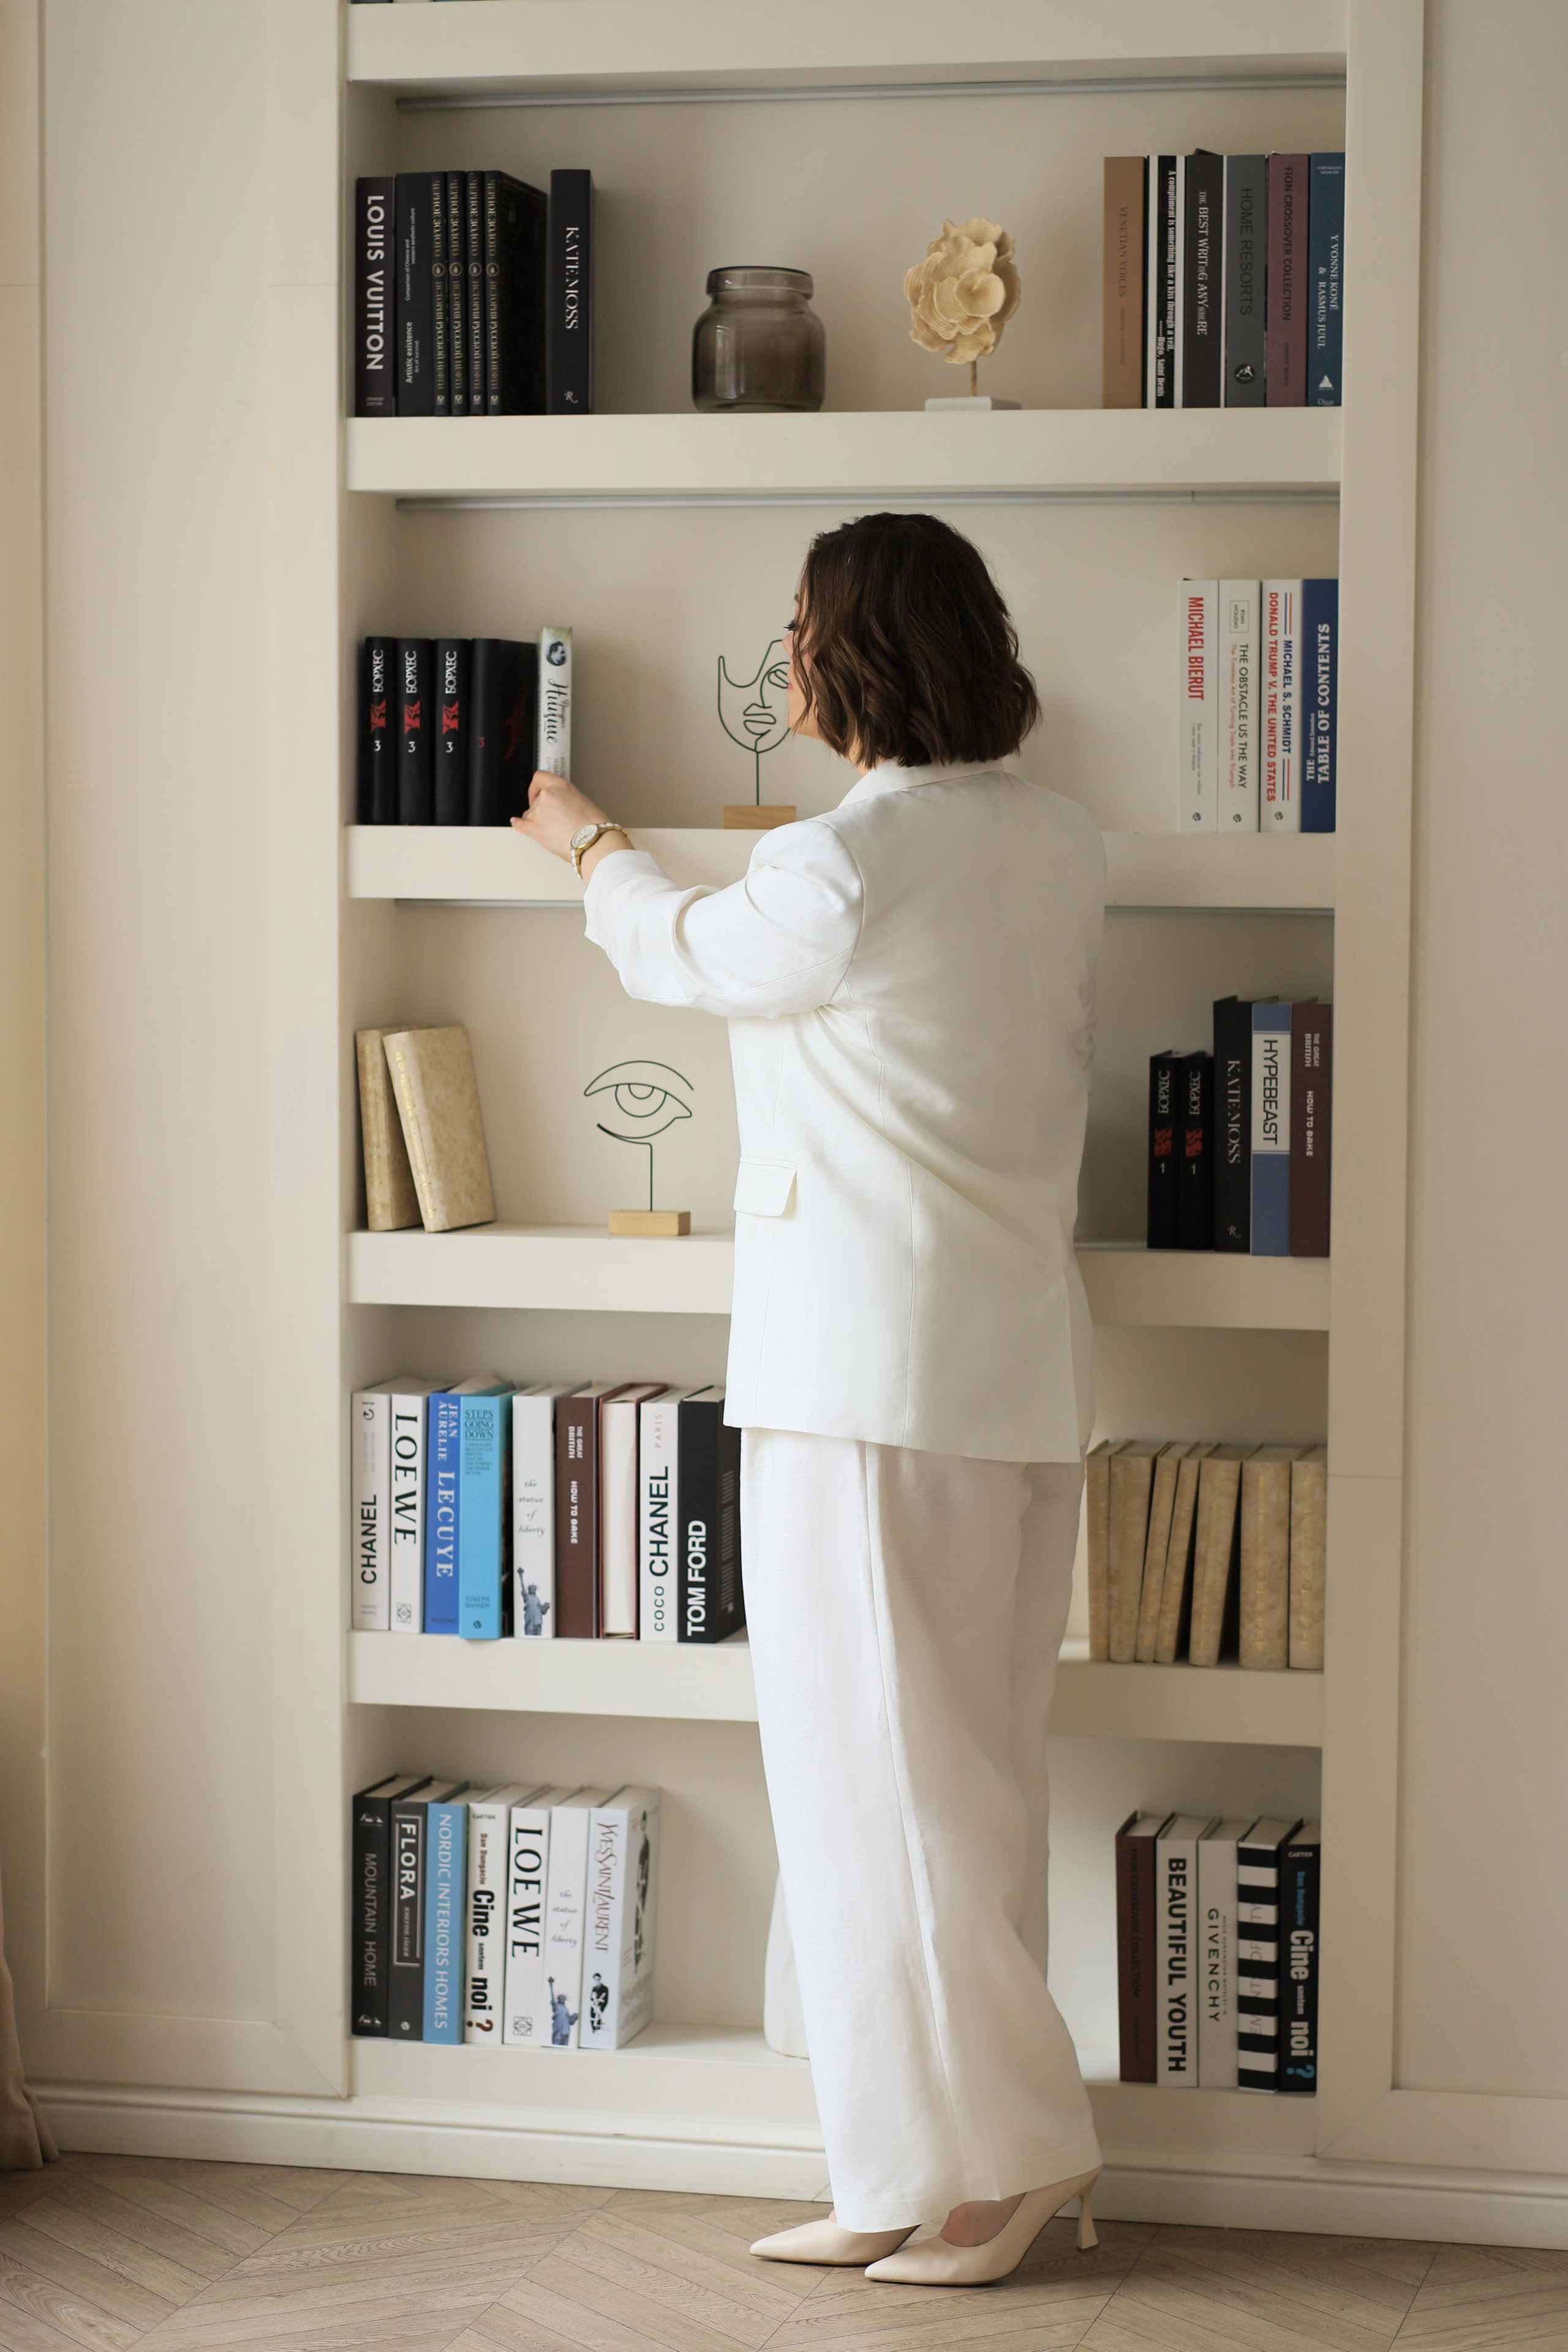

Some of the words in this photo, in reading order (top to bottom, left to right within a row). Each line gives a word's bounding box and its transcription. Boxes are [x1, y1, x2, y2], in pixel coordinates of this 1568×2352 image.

[1167, 177, 1175, 217] compliment
[1284, 167, 1293, 191] FION
[367, 195, 385, 260] LOUIS
[1118, 206, 1128, 258] VENETIAN
[1198, 207, 1209, 236] BEST
[1240, 188, 1253, 235] HOME
[1283, 195, 1293, 255] CROSSOVER
[565, 227, 579, 275] KATE
[1166, 227, 1175, 263] something
[1118, 261, 1128, 297] VOICES
[1239, 241, 1253, 315] RESORTS
[1283, 258, 1292, 320] COLLECTION
[1329, 282, 1340, 311] KONÉ
[366, 270, 385, 370] VUITTON
[565, 277, 579, 330] MOSS
[1166, 301, 1175, 328] through
[1317, 282, 1327, 322] RASMUS
[405, 322, 413, 356] existence
[1316, 324, 1326, 349] JUUL
[405, 357, 413, 383] Artistic
[1188, 597, 1204, 652] MICHAEL
[1269, 592, 1279, 636] DONALD
[372, 649, 384, 692] БОРХЕС
[405, 650, 418, 693] БОРХЕС
[445, 651, 457, 694] БОРХЕС
[1239, 644, 1248, 663] THE
[1268, 639, 1278, 677] TRUMP
[1283, 640, 1292, 688] MICHAEL
[1317, 623, 1330, 706] CONTENTS
[1188, 656, 1204, 700] BIERUT
[1238, 667, 1248, 720] OBSTACLE
[1268, 681, 1277, 690] V.
[1283, 692, 1292, 701] S.
[1268, 693, 1277, 714] THE
[1317, 710, 1330, 731] OF
[374, 740, 382, 752] 3
[408, 741, 416, 753] 3
[446, 741, 454, 753] 3
[478, 737, 485, 748] 3
[1238, 724, 1248, 738] US
[1267, 718, 1276, 758] UNITED
[1281, 705, 1292, 754] SCHMIDT
[1238, 742, 1248, 762] THE
[1306, 759, 1315, 781] THE
[1317, 736, 1330, 783] TABLE
[1238, 764, 1247, 789] WAY
[1267, 761, 1276, 801] STATES
[1158, 1070, 1170, 1114] БОРХЕС
[1189, 1071, 1200, 1115] БОРХЕС
[1227, 1060, 1241, 1110] KATE
[1262, 1039, 1278, 1145] HYPEBEAST
[1227, 1112, 1241, 1164] MOSS
[1306, 1116, 1313, 1128] TO
[1159, 1163, 1164, 1174] 1
[1191, 1164, 1196, 1175] 1
[437, 1401, 448, 1461] AURELIE
[448, 1403, 458, 1438] JEAN
[465, 1409, 493, 1418] STEPS
[465, 1430, 494, 1439] DOWN
[394, 1414, 418, 1545] LOEWE
[435, 1471, 456, 1578] LECUYE
[518, 1526, 546, 1538] liberty
[527, 1510, 537, 1520] of
[570, 1505, 578, 1517] TO
[649, 1466, 669, 1577] CHANEL
[360, 1494, 377, 1585] CHANEL
[687, 1520, 707, 1581] FORD
[654, 1586, 665, 1632] COCO
[687, 1593, 706, 1636] TOM
[400, 1823, 416, 1900] FLORA
[437, 1814, 452, 1878] NORDIC
[364, 1853, 377, 1932] MOUNTAIN
[512, 1827, 543, 1958] LOEWE
[1296, 1871, 1306, 1887] Dan
[435, 1883, 451, 1966] INTERIORS
[472, 1890, 495, 1937] Cine
[560, 1921, 568, 1930] of
[1168, 1858, 1186, 1986] BEAUTIFUL
[551, 1937, 578, 1947] liberty
[1290, 1930, 1314, 1980] Cine
[364, 1942, 377, 1986] HOME
[1208, 1909, 1219, 2022] GIVENCHY
[434, 1970, 448, 2029] HOMES
[472, 1977, 492, 2010] noi
[466, 2019, 493, 2032] ?
[1168, 1993, 1186, 2072] YOUTH
[1290, 2021, 1314, 2056] noi
[1286, 2064, 1315, 2079] ?
